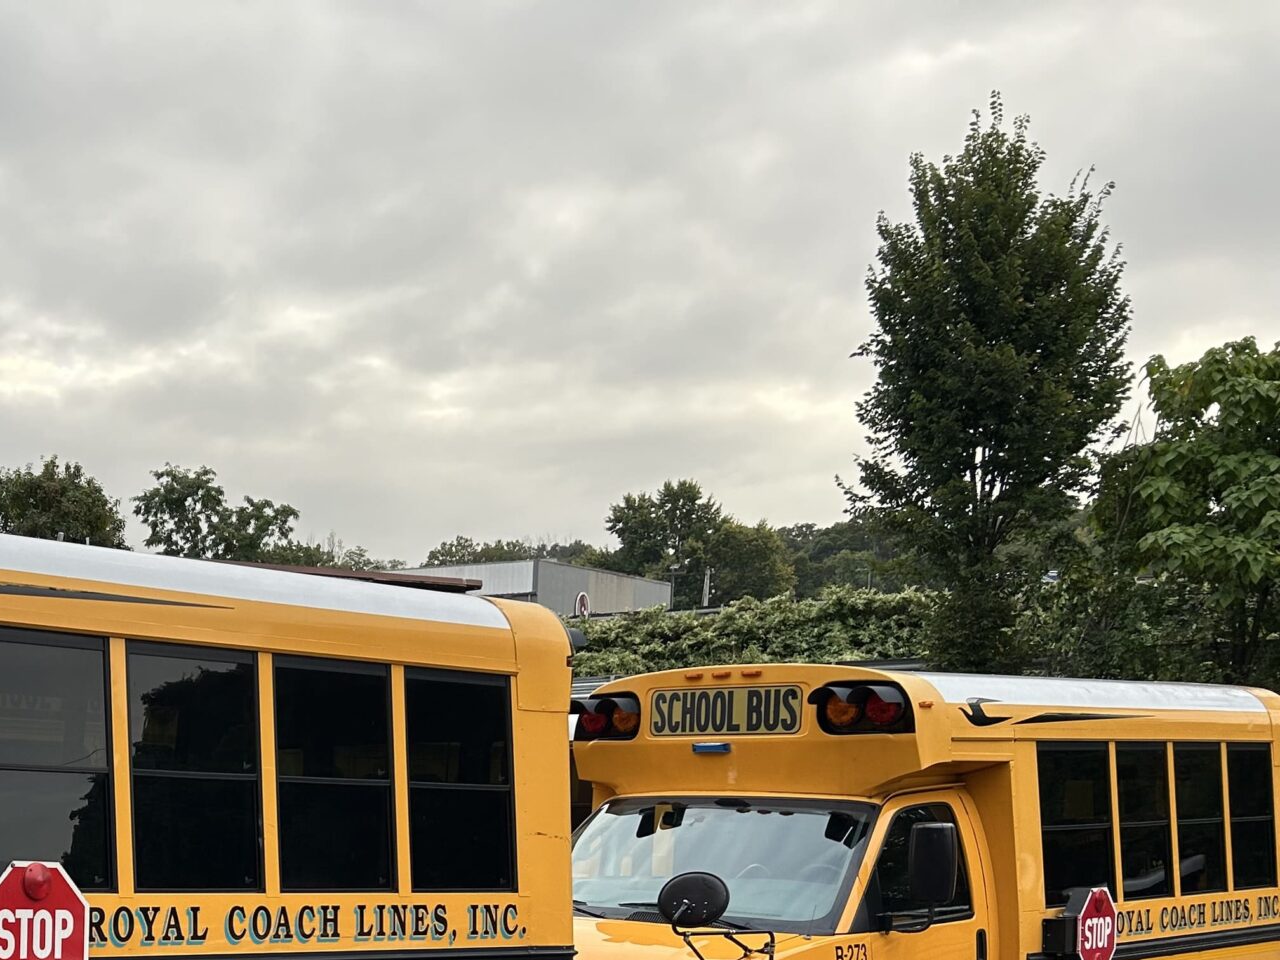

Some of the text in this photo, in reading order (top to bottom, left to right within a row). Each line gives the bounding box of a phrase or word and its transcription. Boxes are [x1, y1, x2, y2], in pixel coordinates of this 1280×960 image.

[653, 688, 799, 734] SCHOOL BUS
[88, 903, 528, 945] ROYAL COACH LINES, INC.
[1084, 916, 1112, 950] STOP
[1116, 909, 1153, 935] OYAL
[1161, 903, 1206, 931] COACH
[1211, 898, 1253, 925] LINES,
